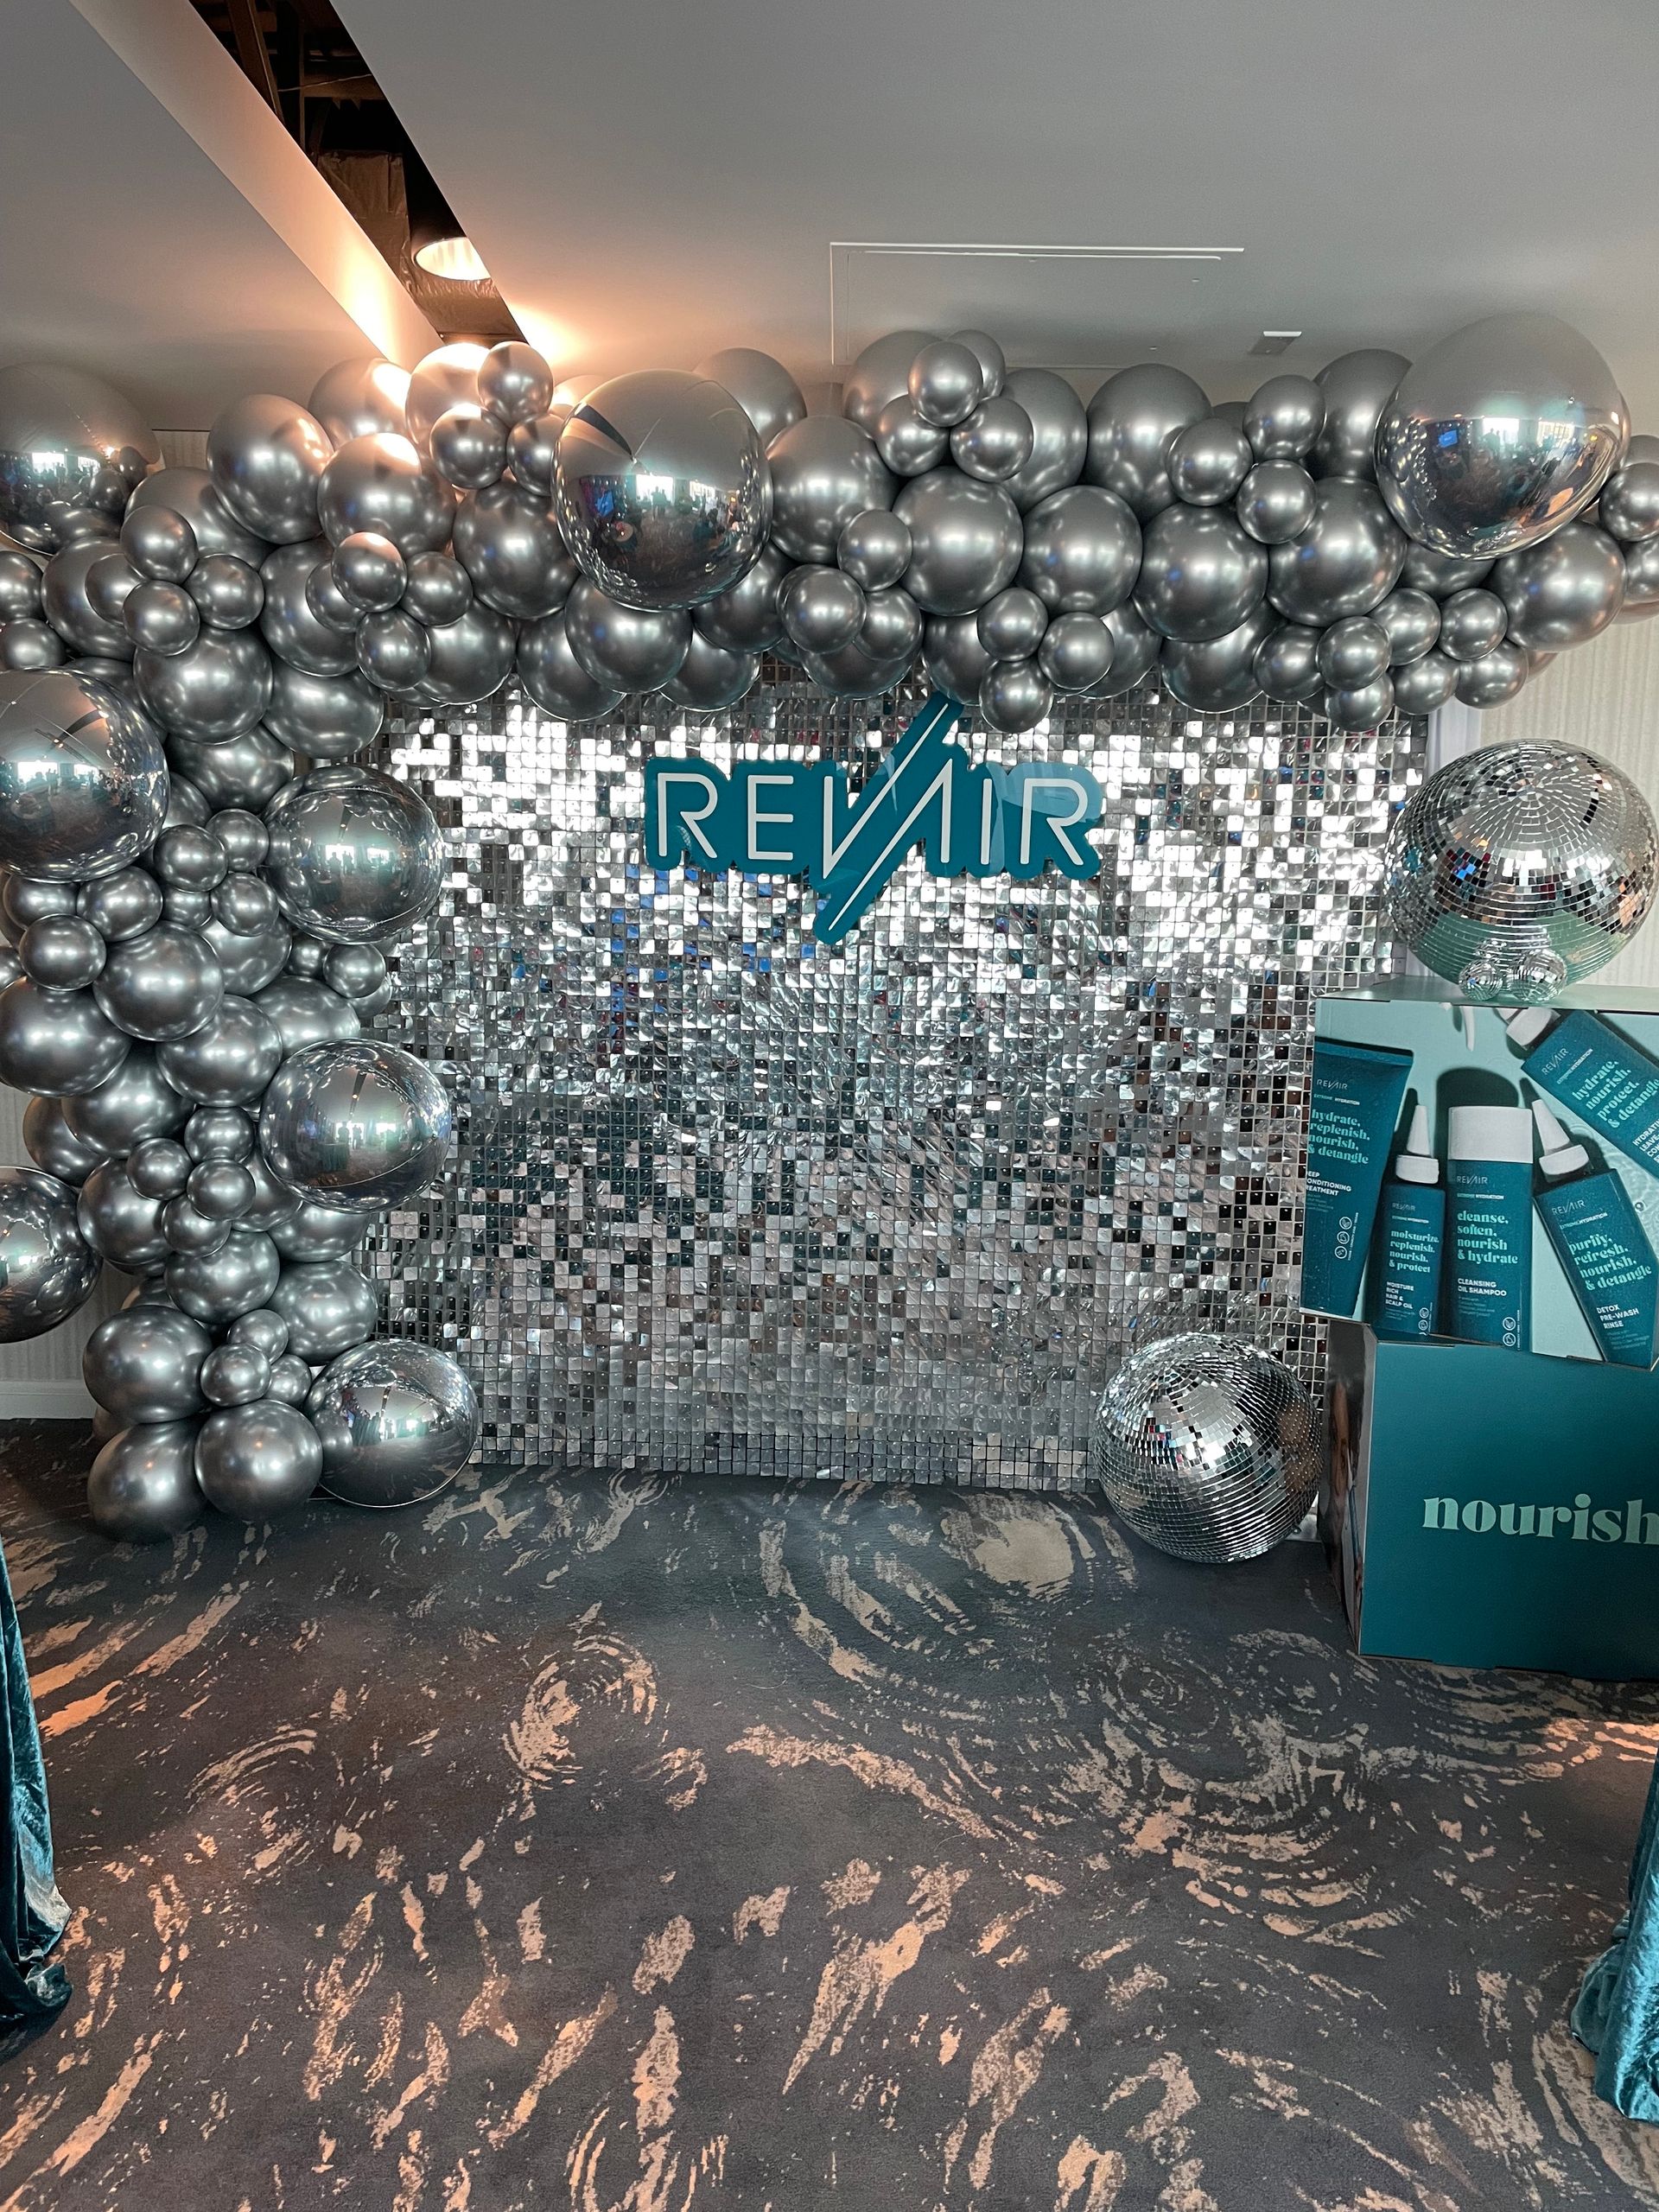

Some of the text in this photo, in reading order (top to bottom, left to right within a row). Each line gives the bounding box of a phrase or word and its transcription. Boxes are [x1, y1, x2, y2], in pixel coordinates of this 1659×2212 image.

[657, 702, 1089, 931] REVAIR
[1541, 1047, 1569, 1075] REVAIR
[1571, 1048, 1593, 1071] HYDRATION
[1316, 1078, 1348, 1090] REVAIR
[1607, 1118, 1620, 1128] &
[1307, 1143, 1369, 1164] & detangle
[1306, 1178, 1352, 1192] ONDITIONING
[1456, 1174, 1488, 1185] REVAIR
[1306, 1185, 1339, 1196] REATMENT
[1551, 1198, 1586, 1216] REVAIR
[1577, 1211, 1608, 1224] HYDRATION
[1457, 1237, 1508, 1250] nourish
[1458, 1249, 1518, 1264] & hydrate
[1389, 1259, 1431, 1273] & protect
[1458, 1278, 1497, 1287] CLEANSING
[1585, 1265, 1652, 1291] & detangle
[1469, 1287, 1507, 1296] SHAMPOO
[1596, 1304, 1620, 1313] DETOX
[1599, 1307, 1639, 1322] PRE-WASH
[1603, 1320, 1624, 1329] RINSE
[1421, 1493, 1659, 1546] nourish
